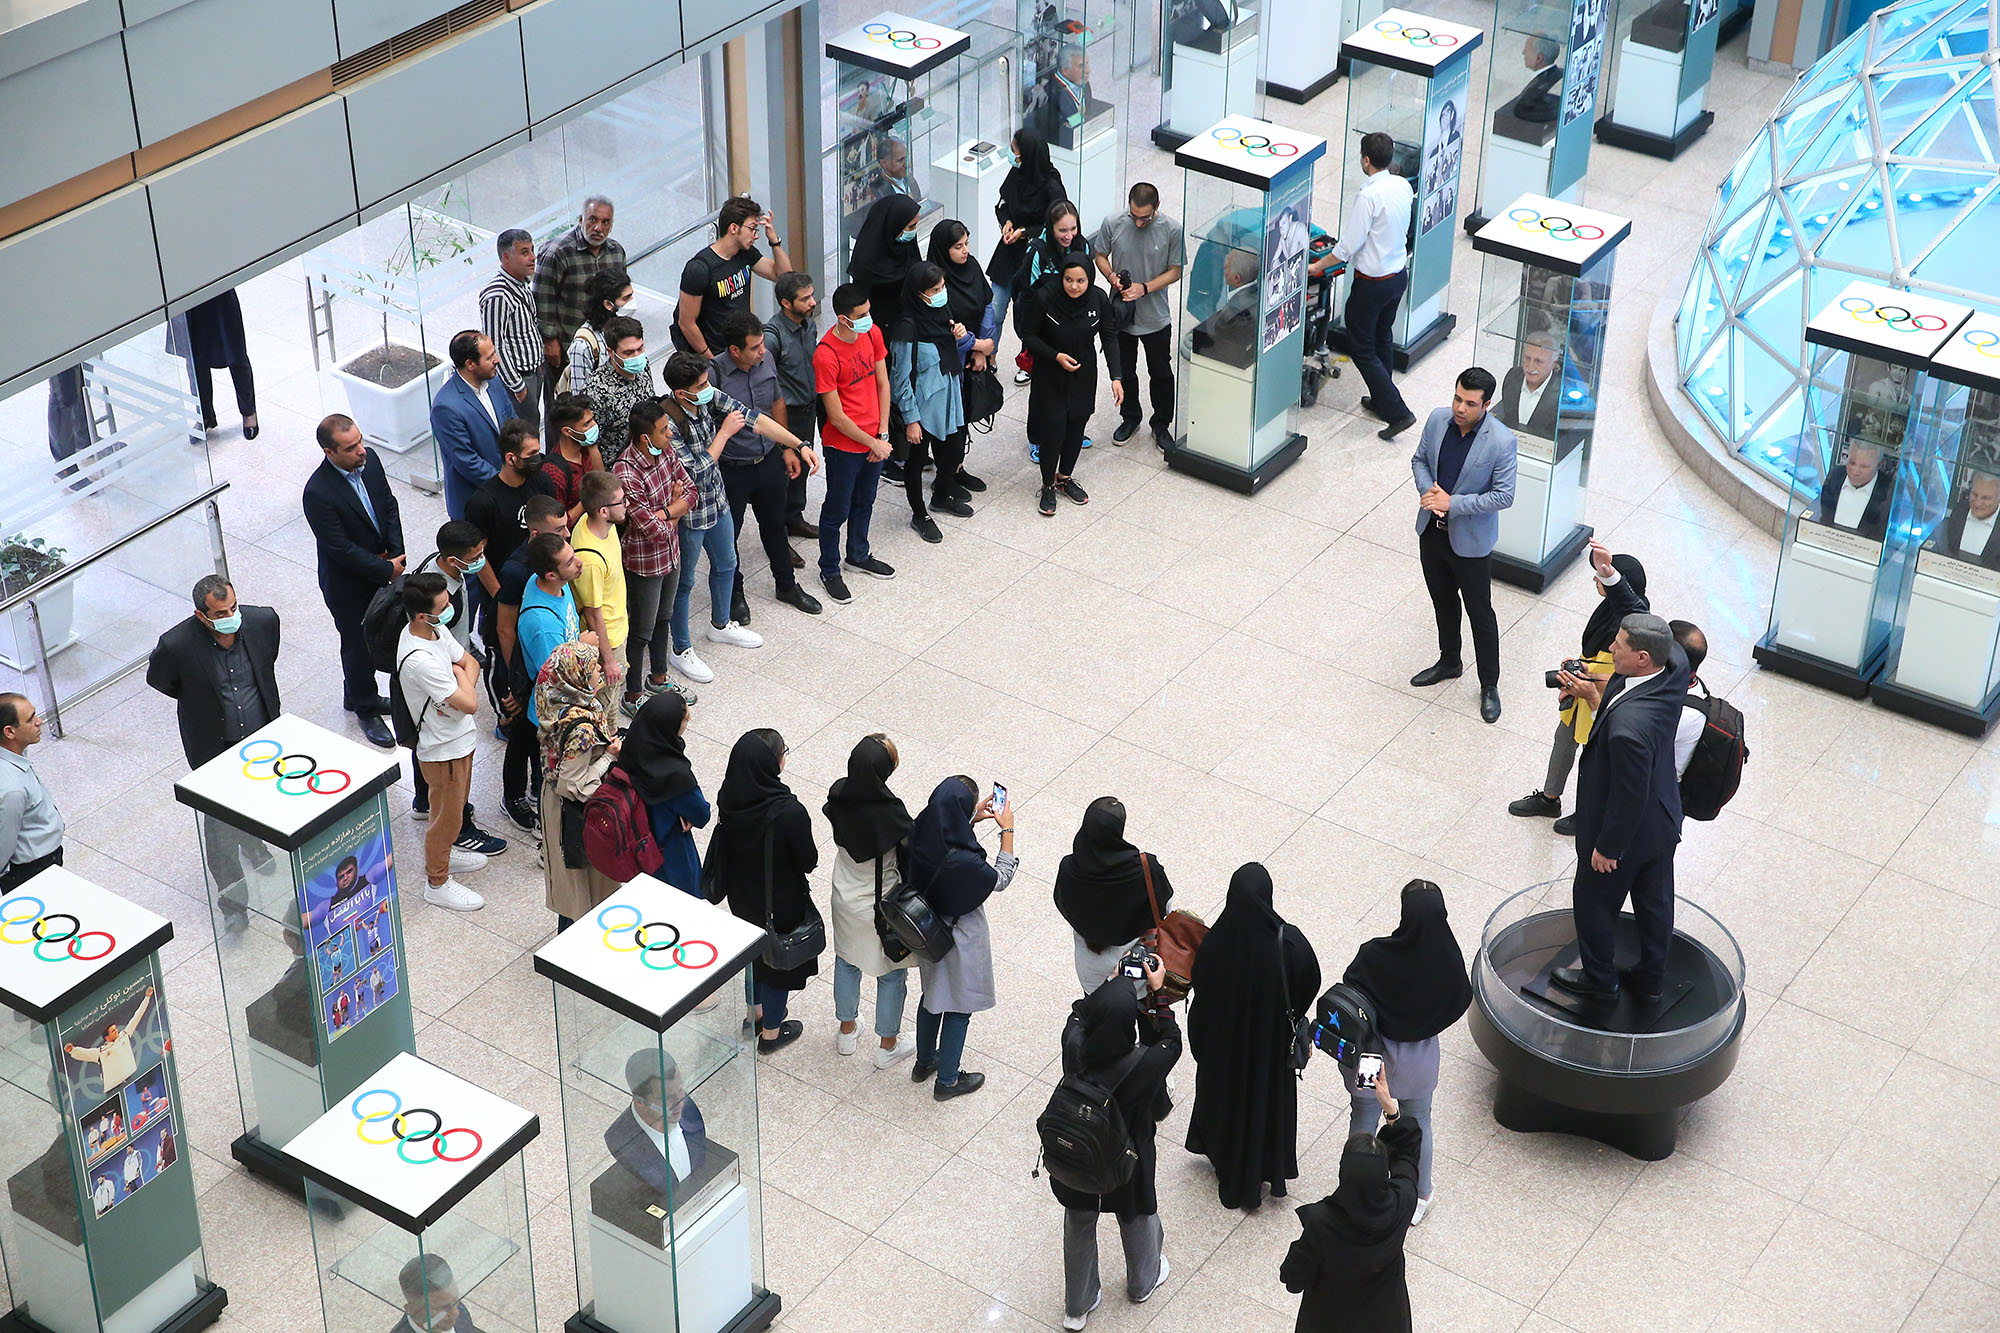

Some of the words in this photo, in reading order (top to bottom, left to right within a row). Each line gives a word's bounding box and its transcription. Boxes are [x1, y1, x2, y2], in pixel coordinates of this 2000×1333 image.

[355, 814, 375, 831] حسین
[330, 828, 354, 846] رضازاده
[122, 976, 145, 995] حسین
[100, 989, 121, 1011] توکلی
